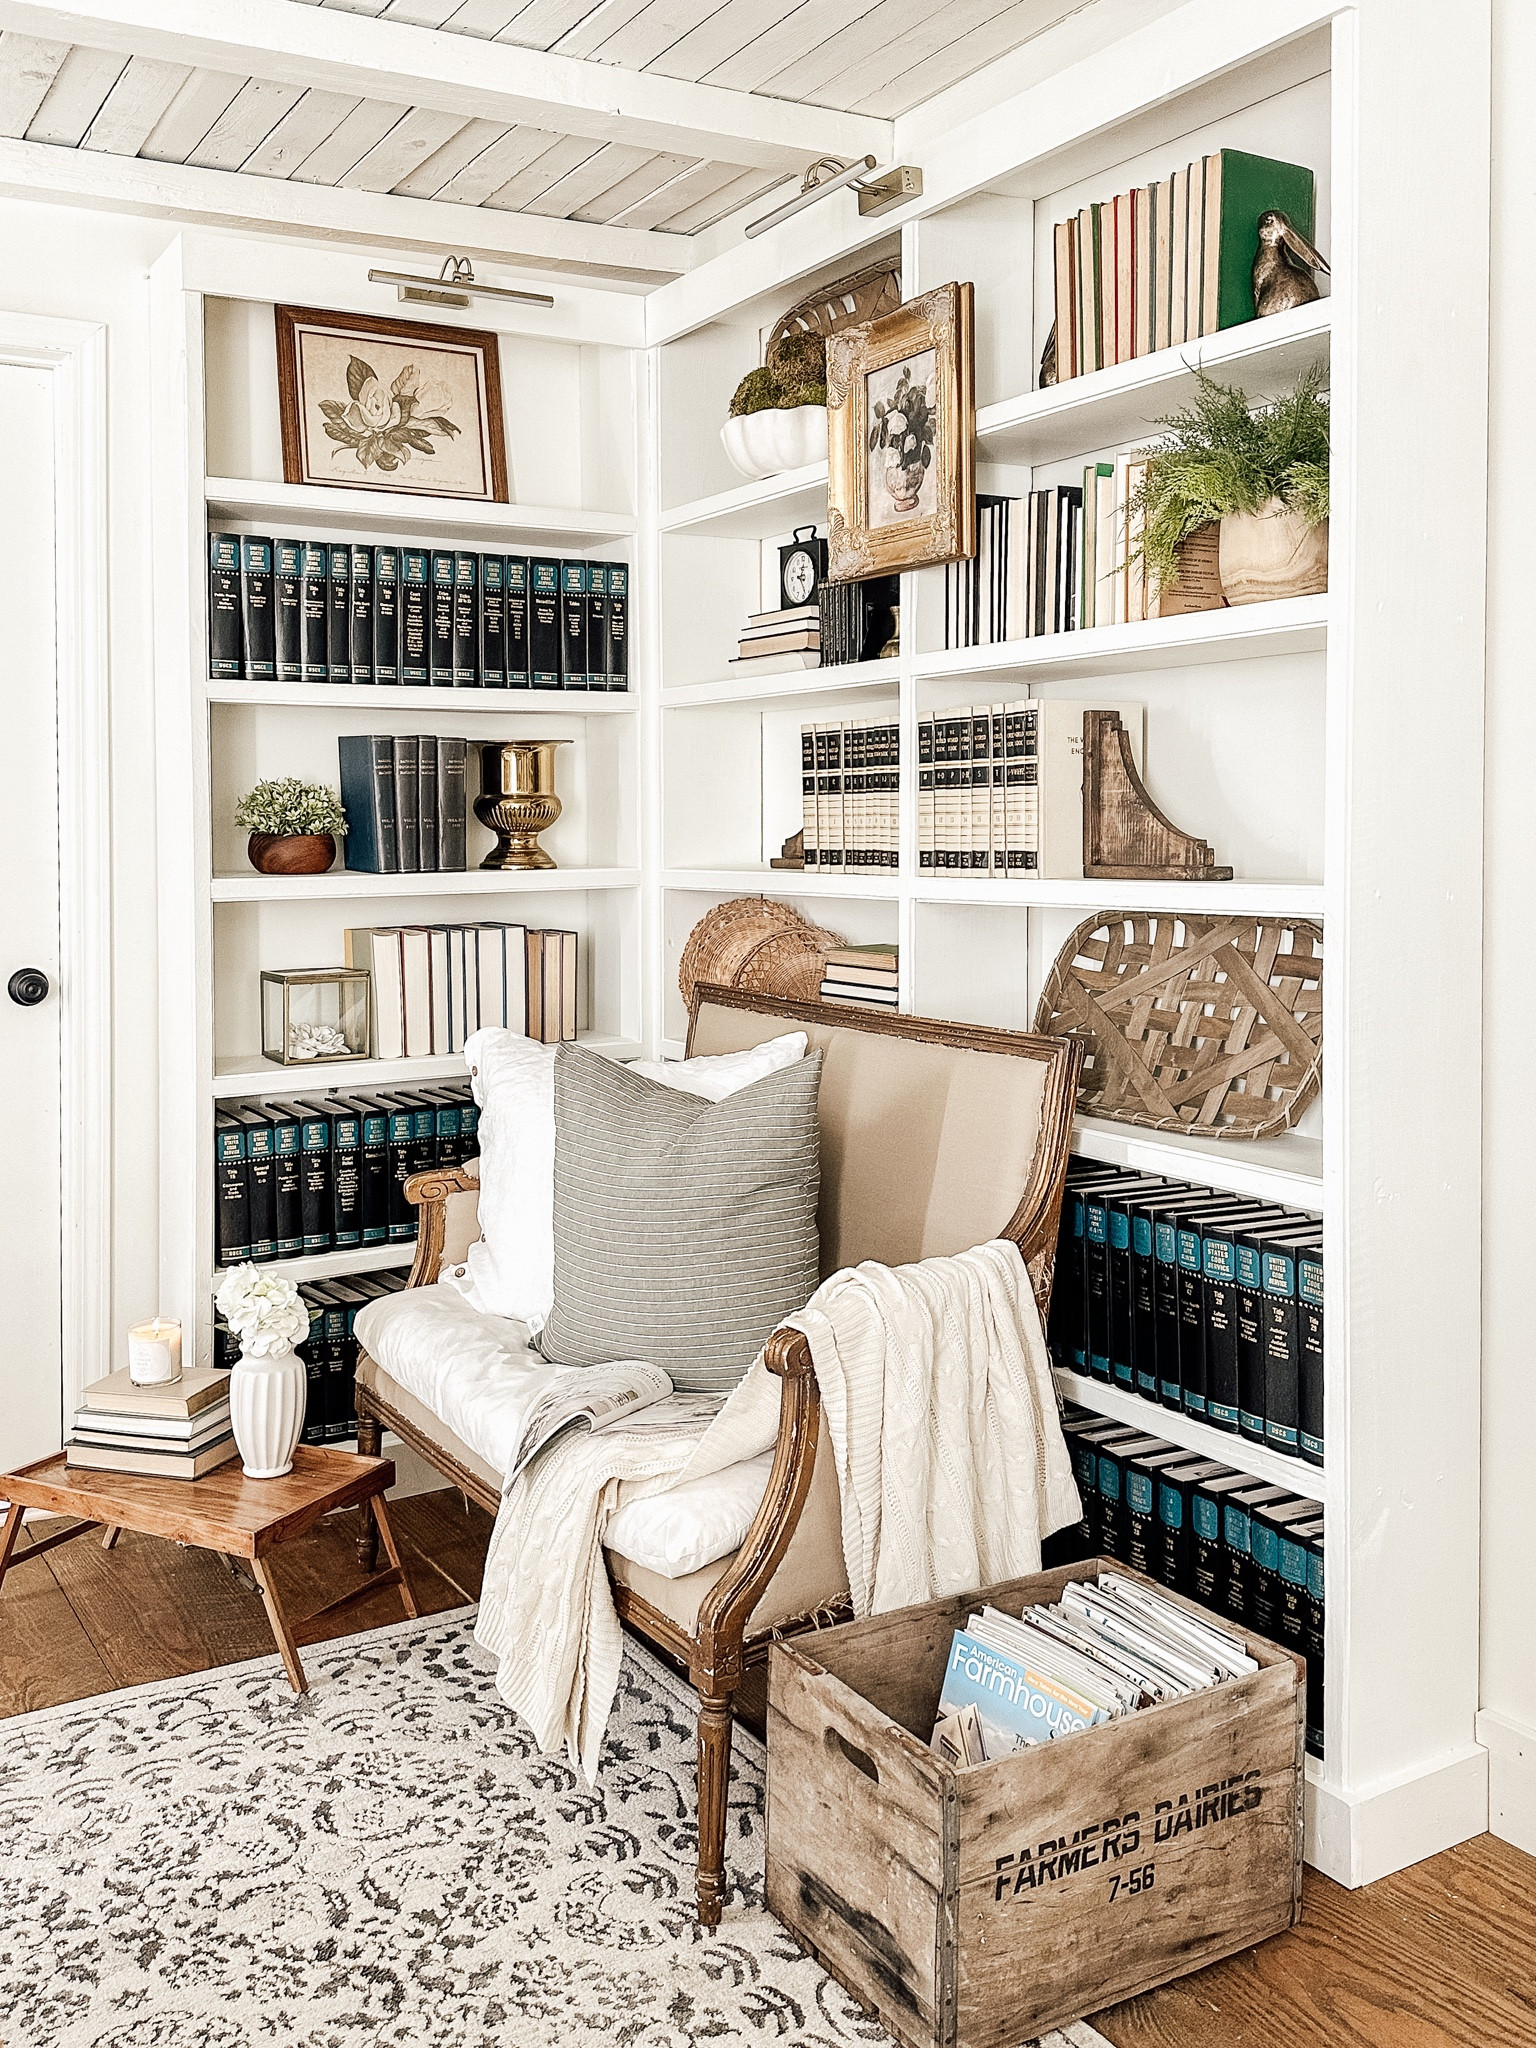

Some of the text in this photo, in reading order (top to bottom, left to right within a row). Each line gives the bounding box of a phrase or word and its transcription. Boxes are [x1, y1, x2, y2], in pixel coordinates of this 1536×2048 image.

[1208, 1242, 1227, 1251] UNITED
[1208, 1249, 1228, 1258] STATES
[1211, 1256, 1225, 1264] CODE
[1269, 1257, 1285, 1265] UNITED
[1208, 1262, 1229, 1272] SERVICE
[1269, 1264, 1286, 1273] STATES
[1304, 1272, 1323, 1282] STATES
[1269, 1278, 1287, 1287] SERVICE
[1307, 1280, 1320, 1289] CODE
[1243, 1298, 1252, 1306] Title
[1272, 1307, 1284, 1316] Title
[1309, 1316, 1319, 1325] Title
[1308, 1337, 1320, 1345] Labor
[1214, 1408, 1228, 1416] USCS
[1272, 1427, 1286, 1437] USCS
[1304, 1439, 1318, 1448] USCS
[1286, 1594, 1297, 1604] Title
[970, 1645, 1017, 1678] American
[952, 1643, 1085, 1735] Farmhouse
[1016, 1733, 1031, 1748] The
[996, 1769, 1263, 1901] FARMERS DAIRIES
[1109, 1863, 1154, 1902] 7-56
